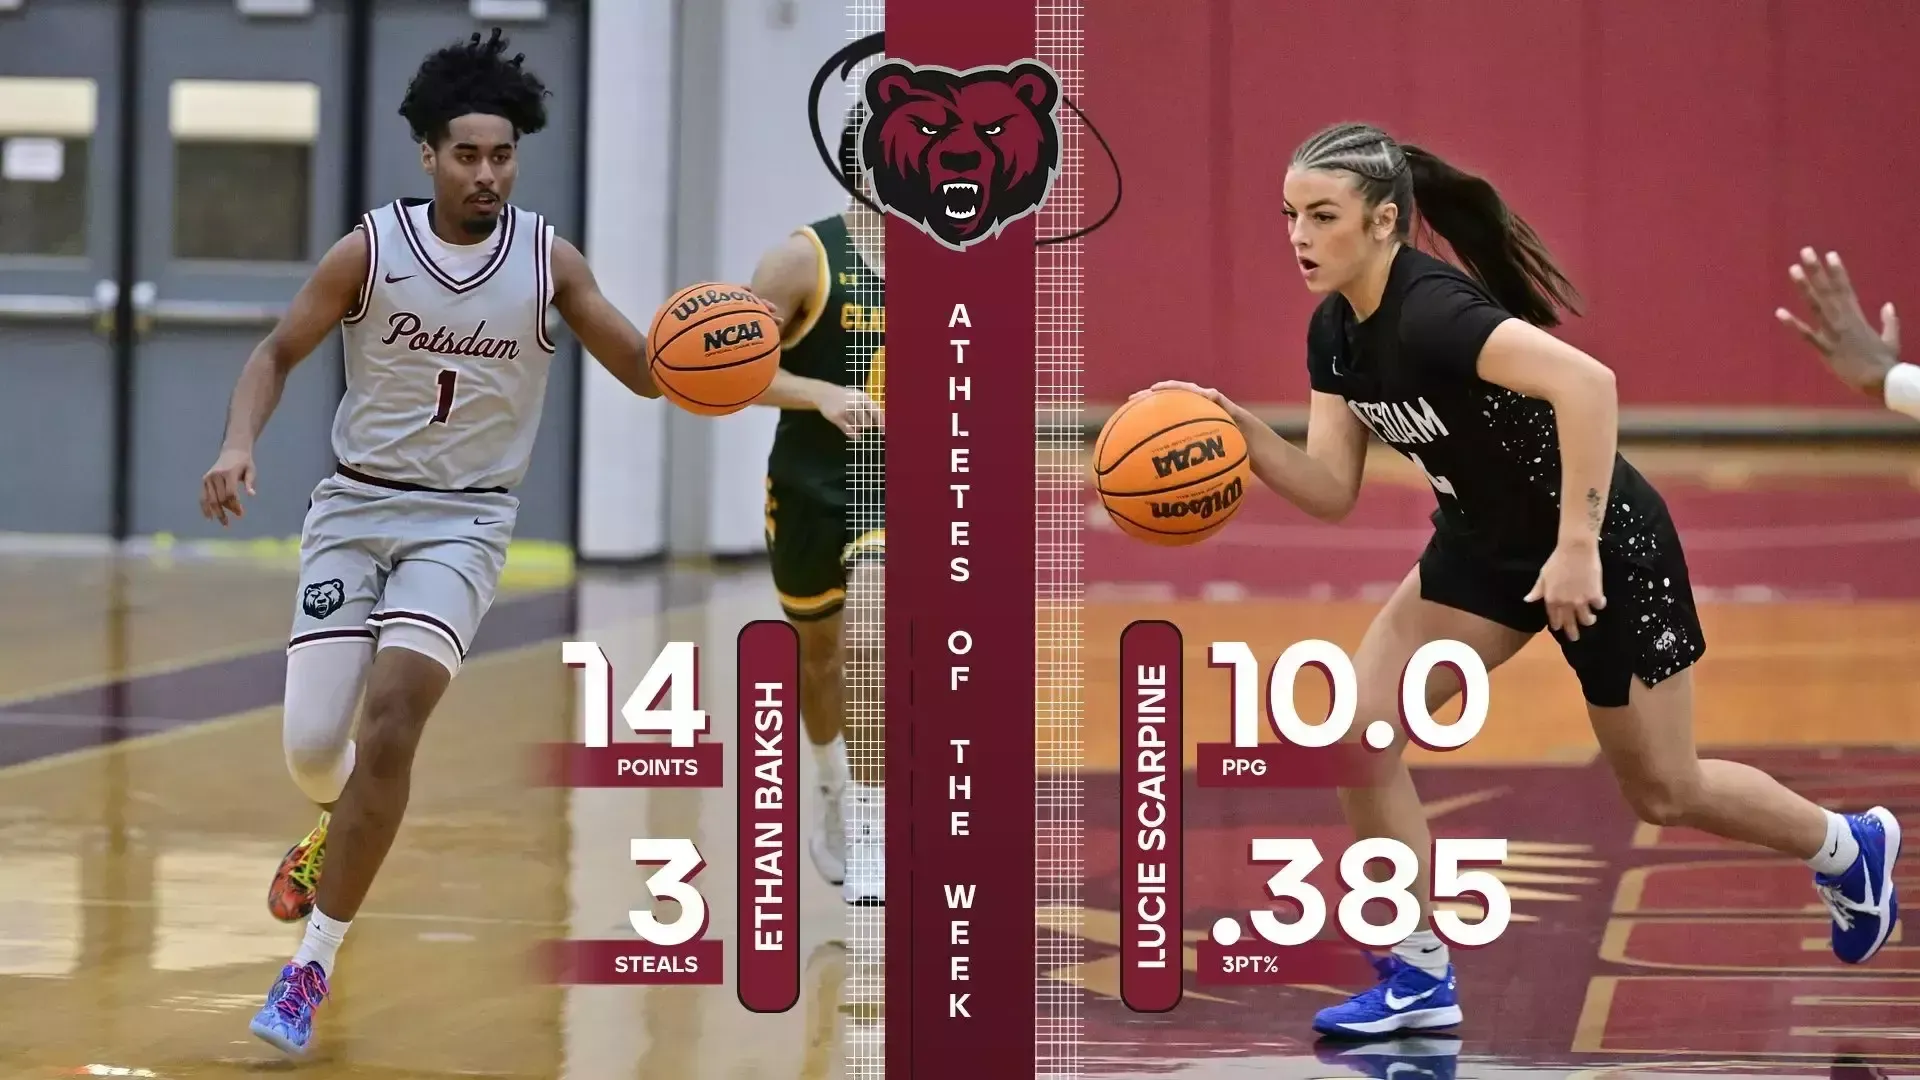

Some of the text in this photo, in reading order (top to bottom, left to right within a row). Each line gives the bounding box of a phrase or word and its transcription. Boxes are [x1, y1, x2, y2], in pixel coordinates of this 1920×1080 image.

[670, 289, 760, 321] Wilson
[381, 310, 521, 361] Potsdam
[703, 320, 764, 352] NCAA
[429, 367, 459, 426] 1
[1151, 435, 1226, 478] NCAA
[1151, 476, 1243, 519] Wilson
